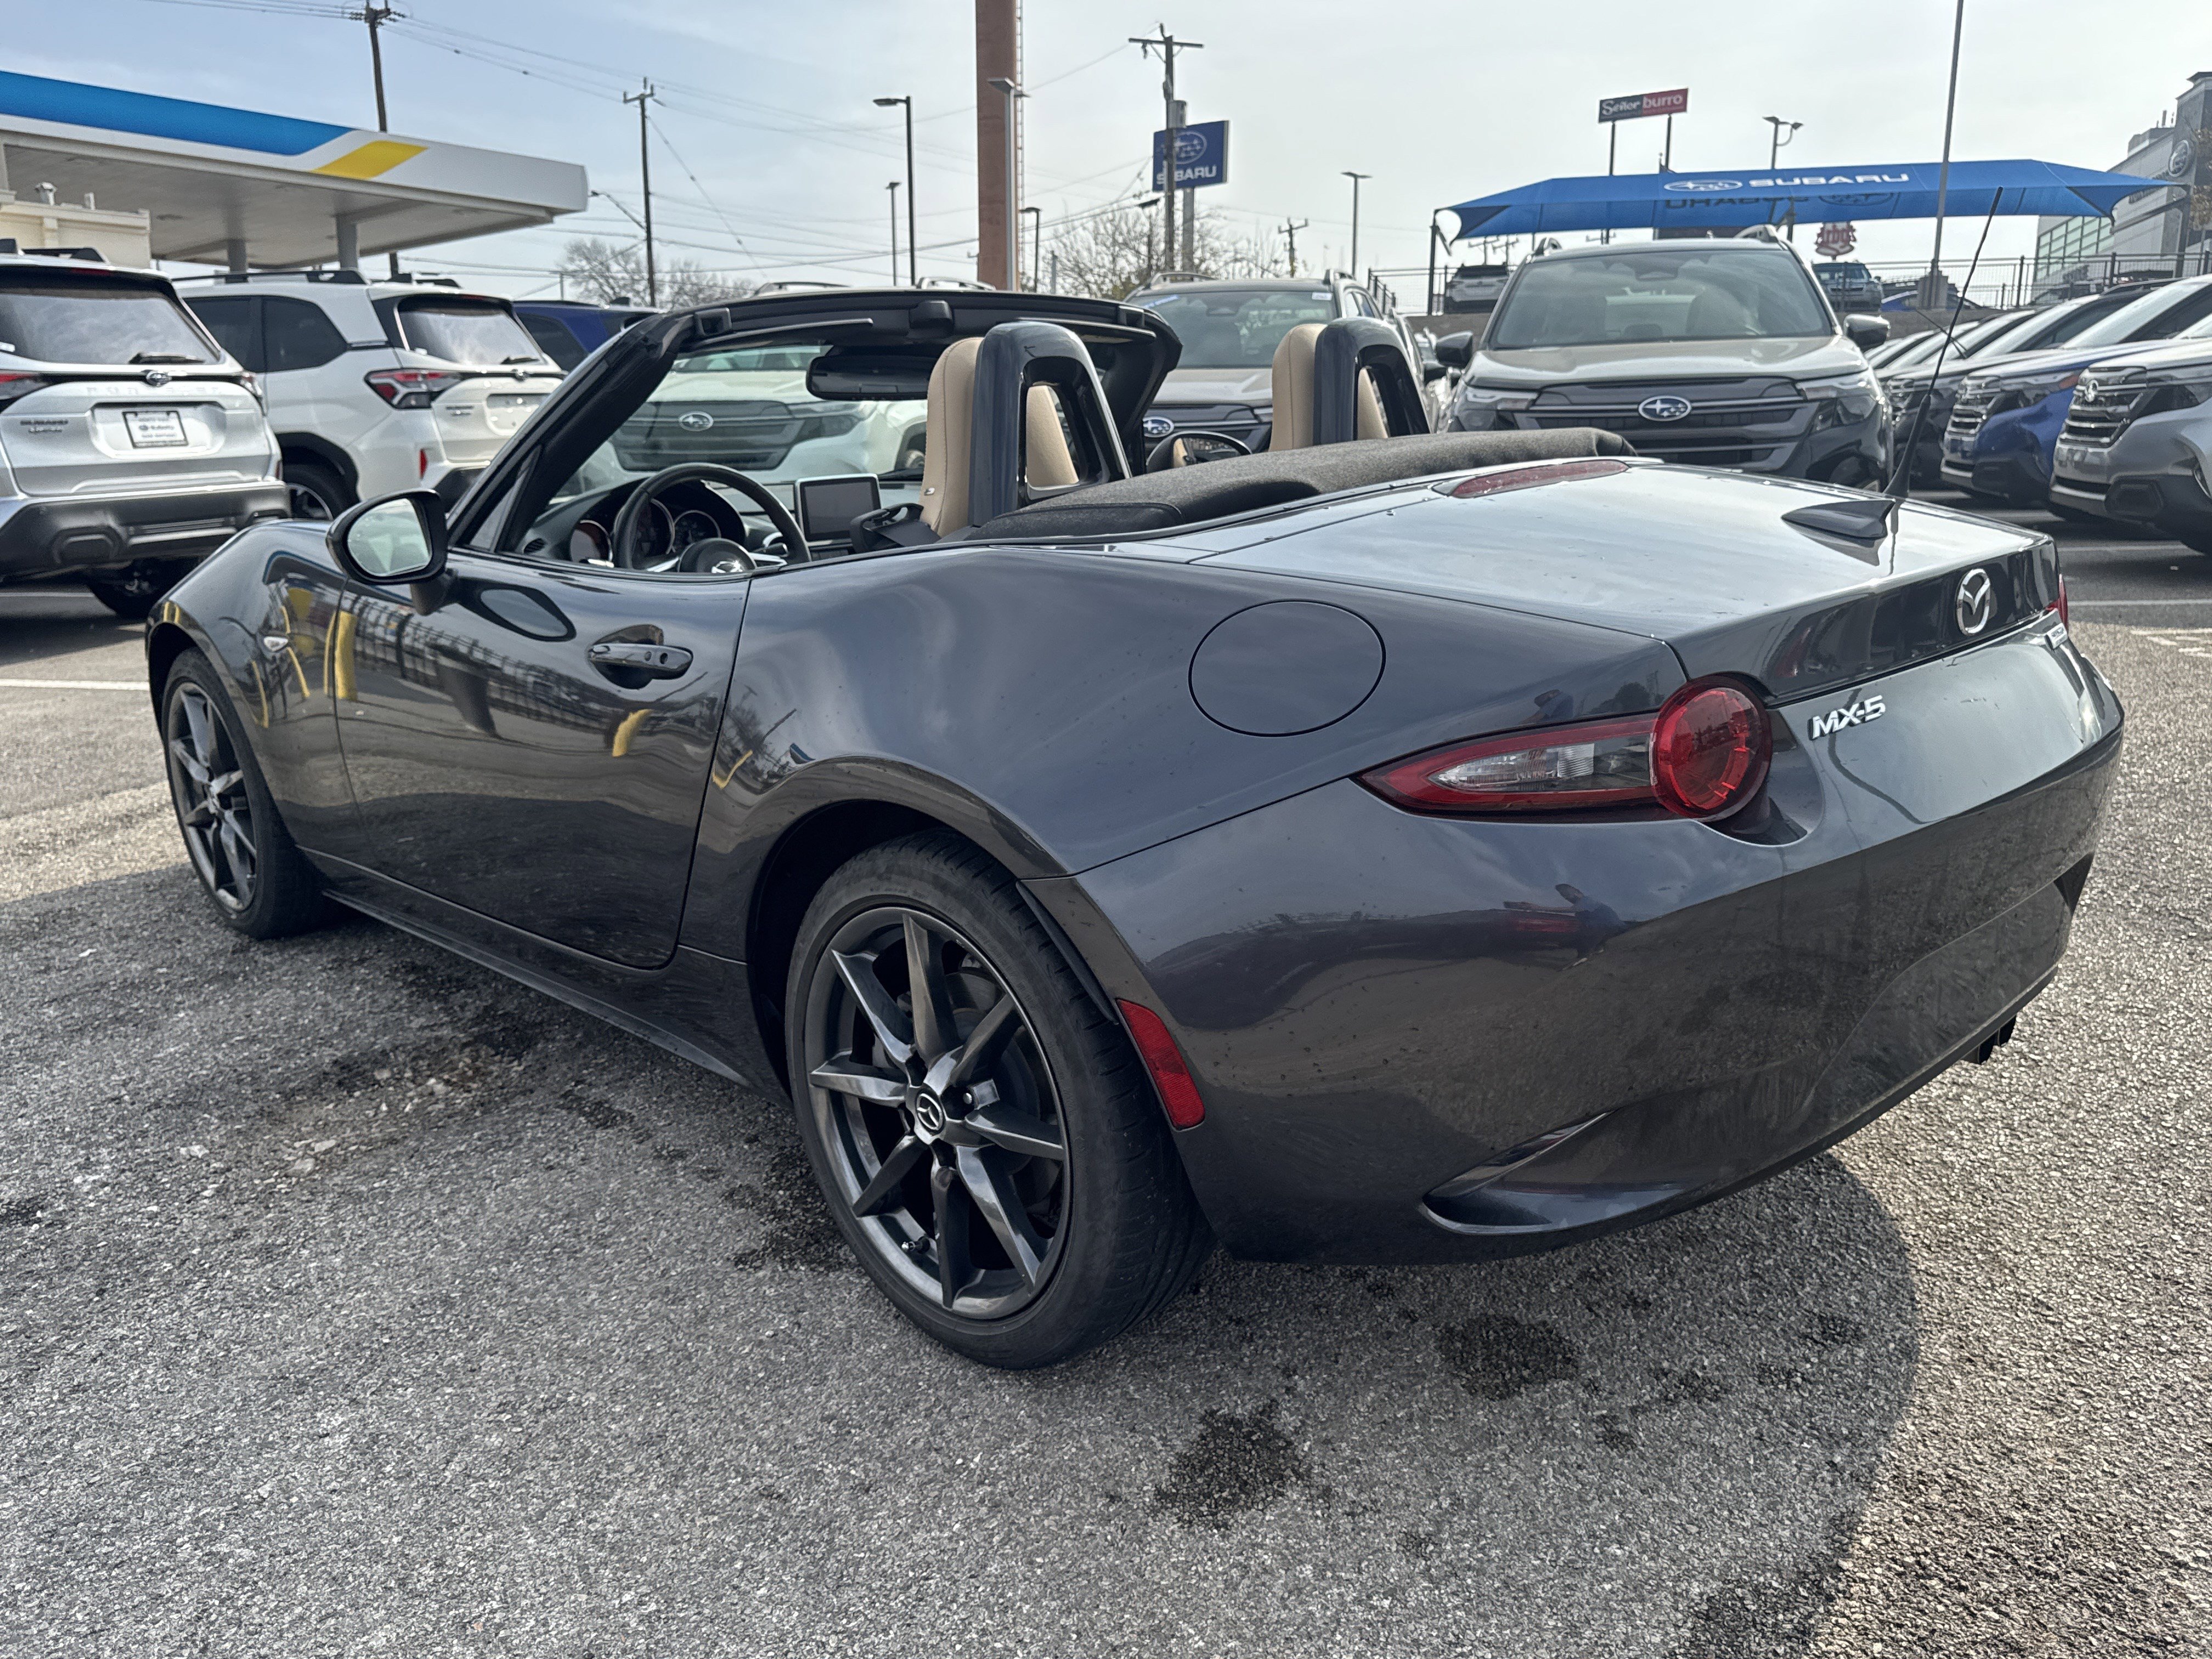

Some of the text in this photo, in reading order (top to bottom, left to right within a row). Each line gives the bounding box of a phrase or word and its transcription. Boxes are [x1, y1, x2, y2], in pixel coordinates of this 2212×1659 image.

[1643, 94, 1684, 109] burro
[1156, 165, 1217, 185] SBARU
[1748, 173, 1909, 188] SUBARU
[1812, 695, 1886, 740] MX-5
